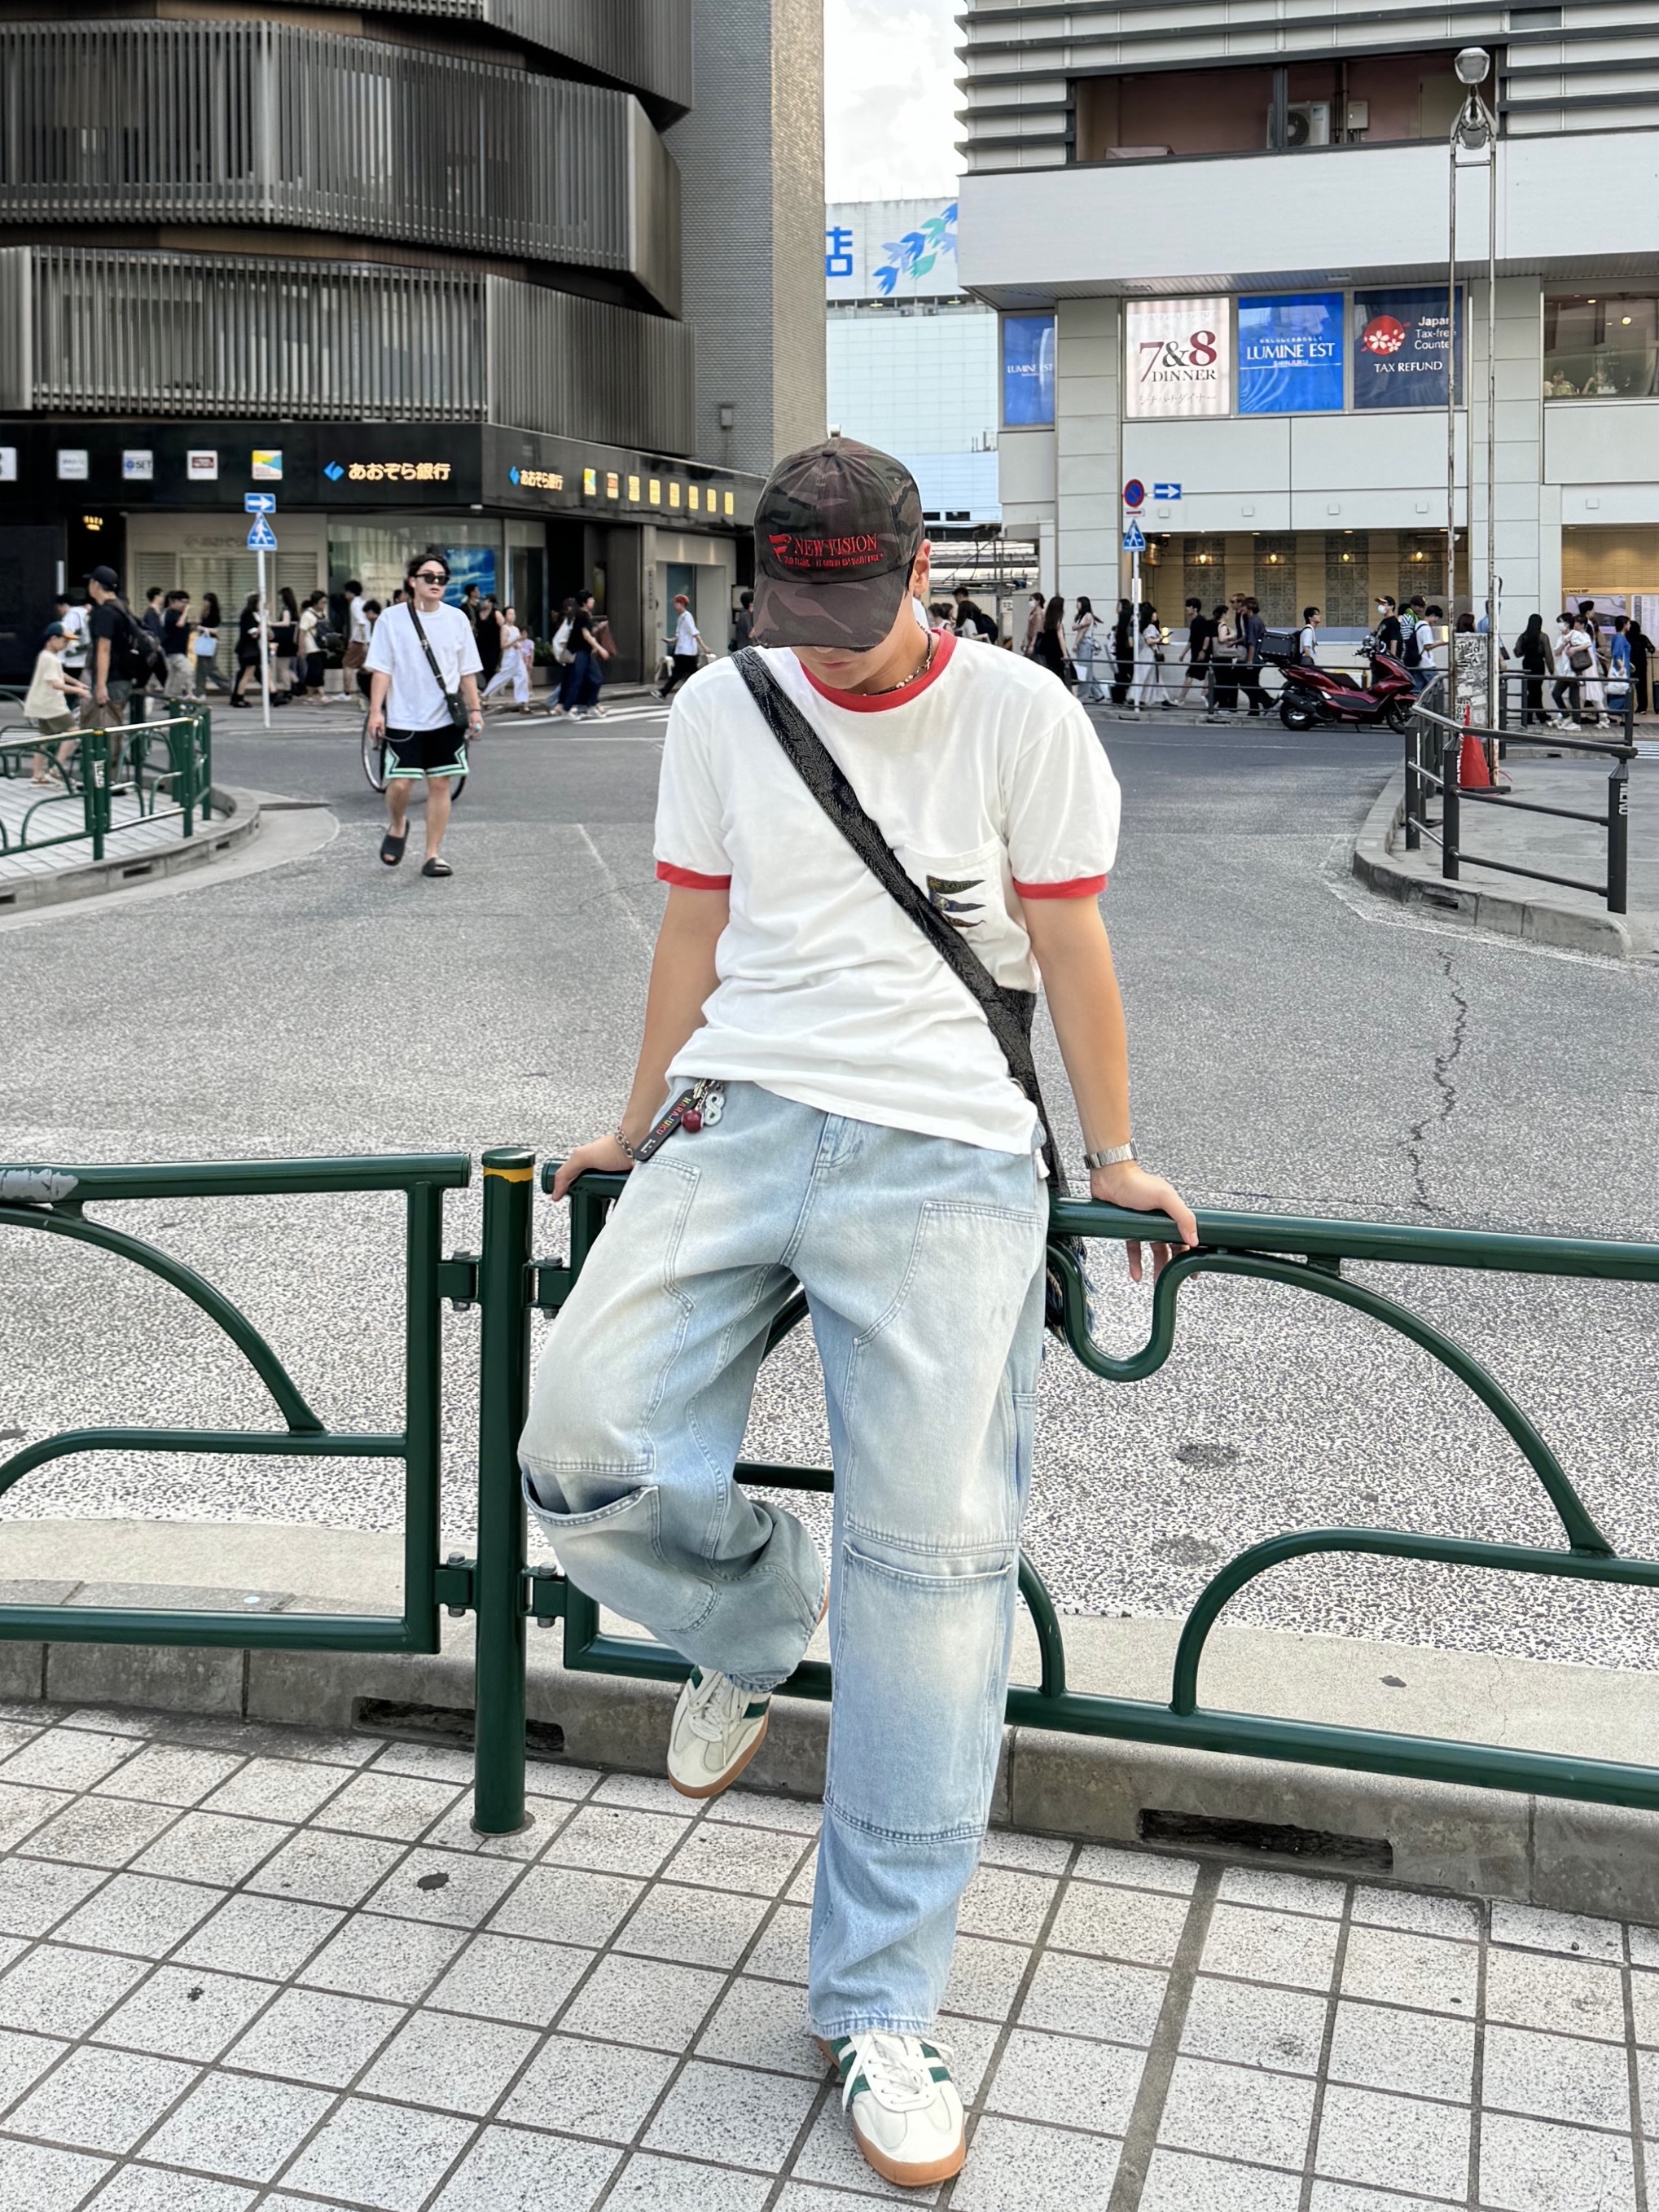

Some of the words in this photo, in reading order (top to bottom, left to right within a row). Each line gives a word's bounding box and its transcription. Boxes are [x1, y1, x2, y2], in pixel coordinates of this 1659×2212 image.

[1415, 328, 1456, 339] Tax-fre
[1247, 344, 1305, 360] LUMINE
[1310, 342, 1336, 358] EST
[1415, 340, 1450, 350] Counte
[1139, 330, 1218, 383] 7&8
[1152, 369, 1218, 383] DINNER
[1374, 363, 1395, 373] TAX
[1398, 361, 1443, 372] REFUND
[349, 463, 451, 481] あおぞら銀行
[794, 538, 824, 557] NEW
[826, 533, 878, 556] VISION
[656, 1096, 691, 1135] HARAJUKU
